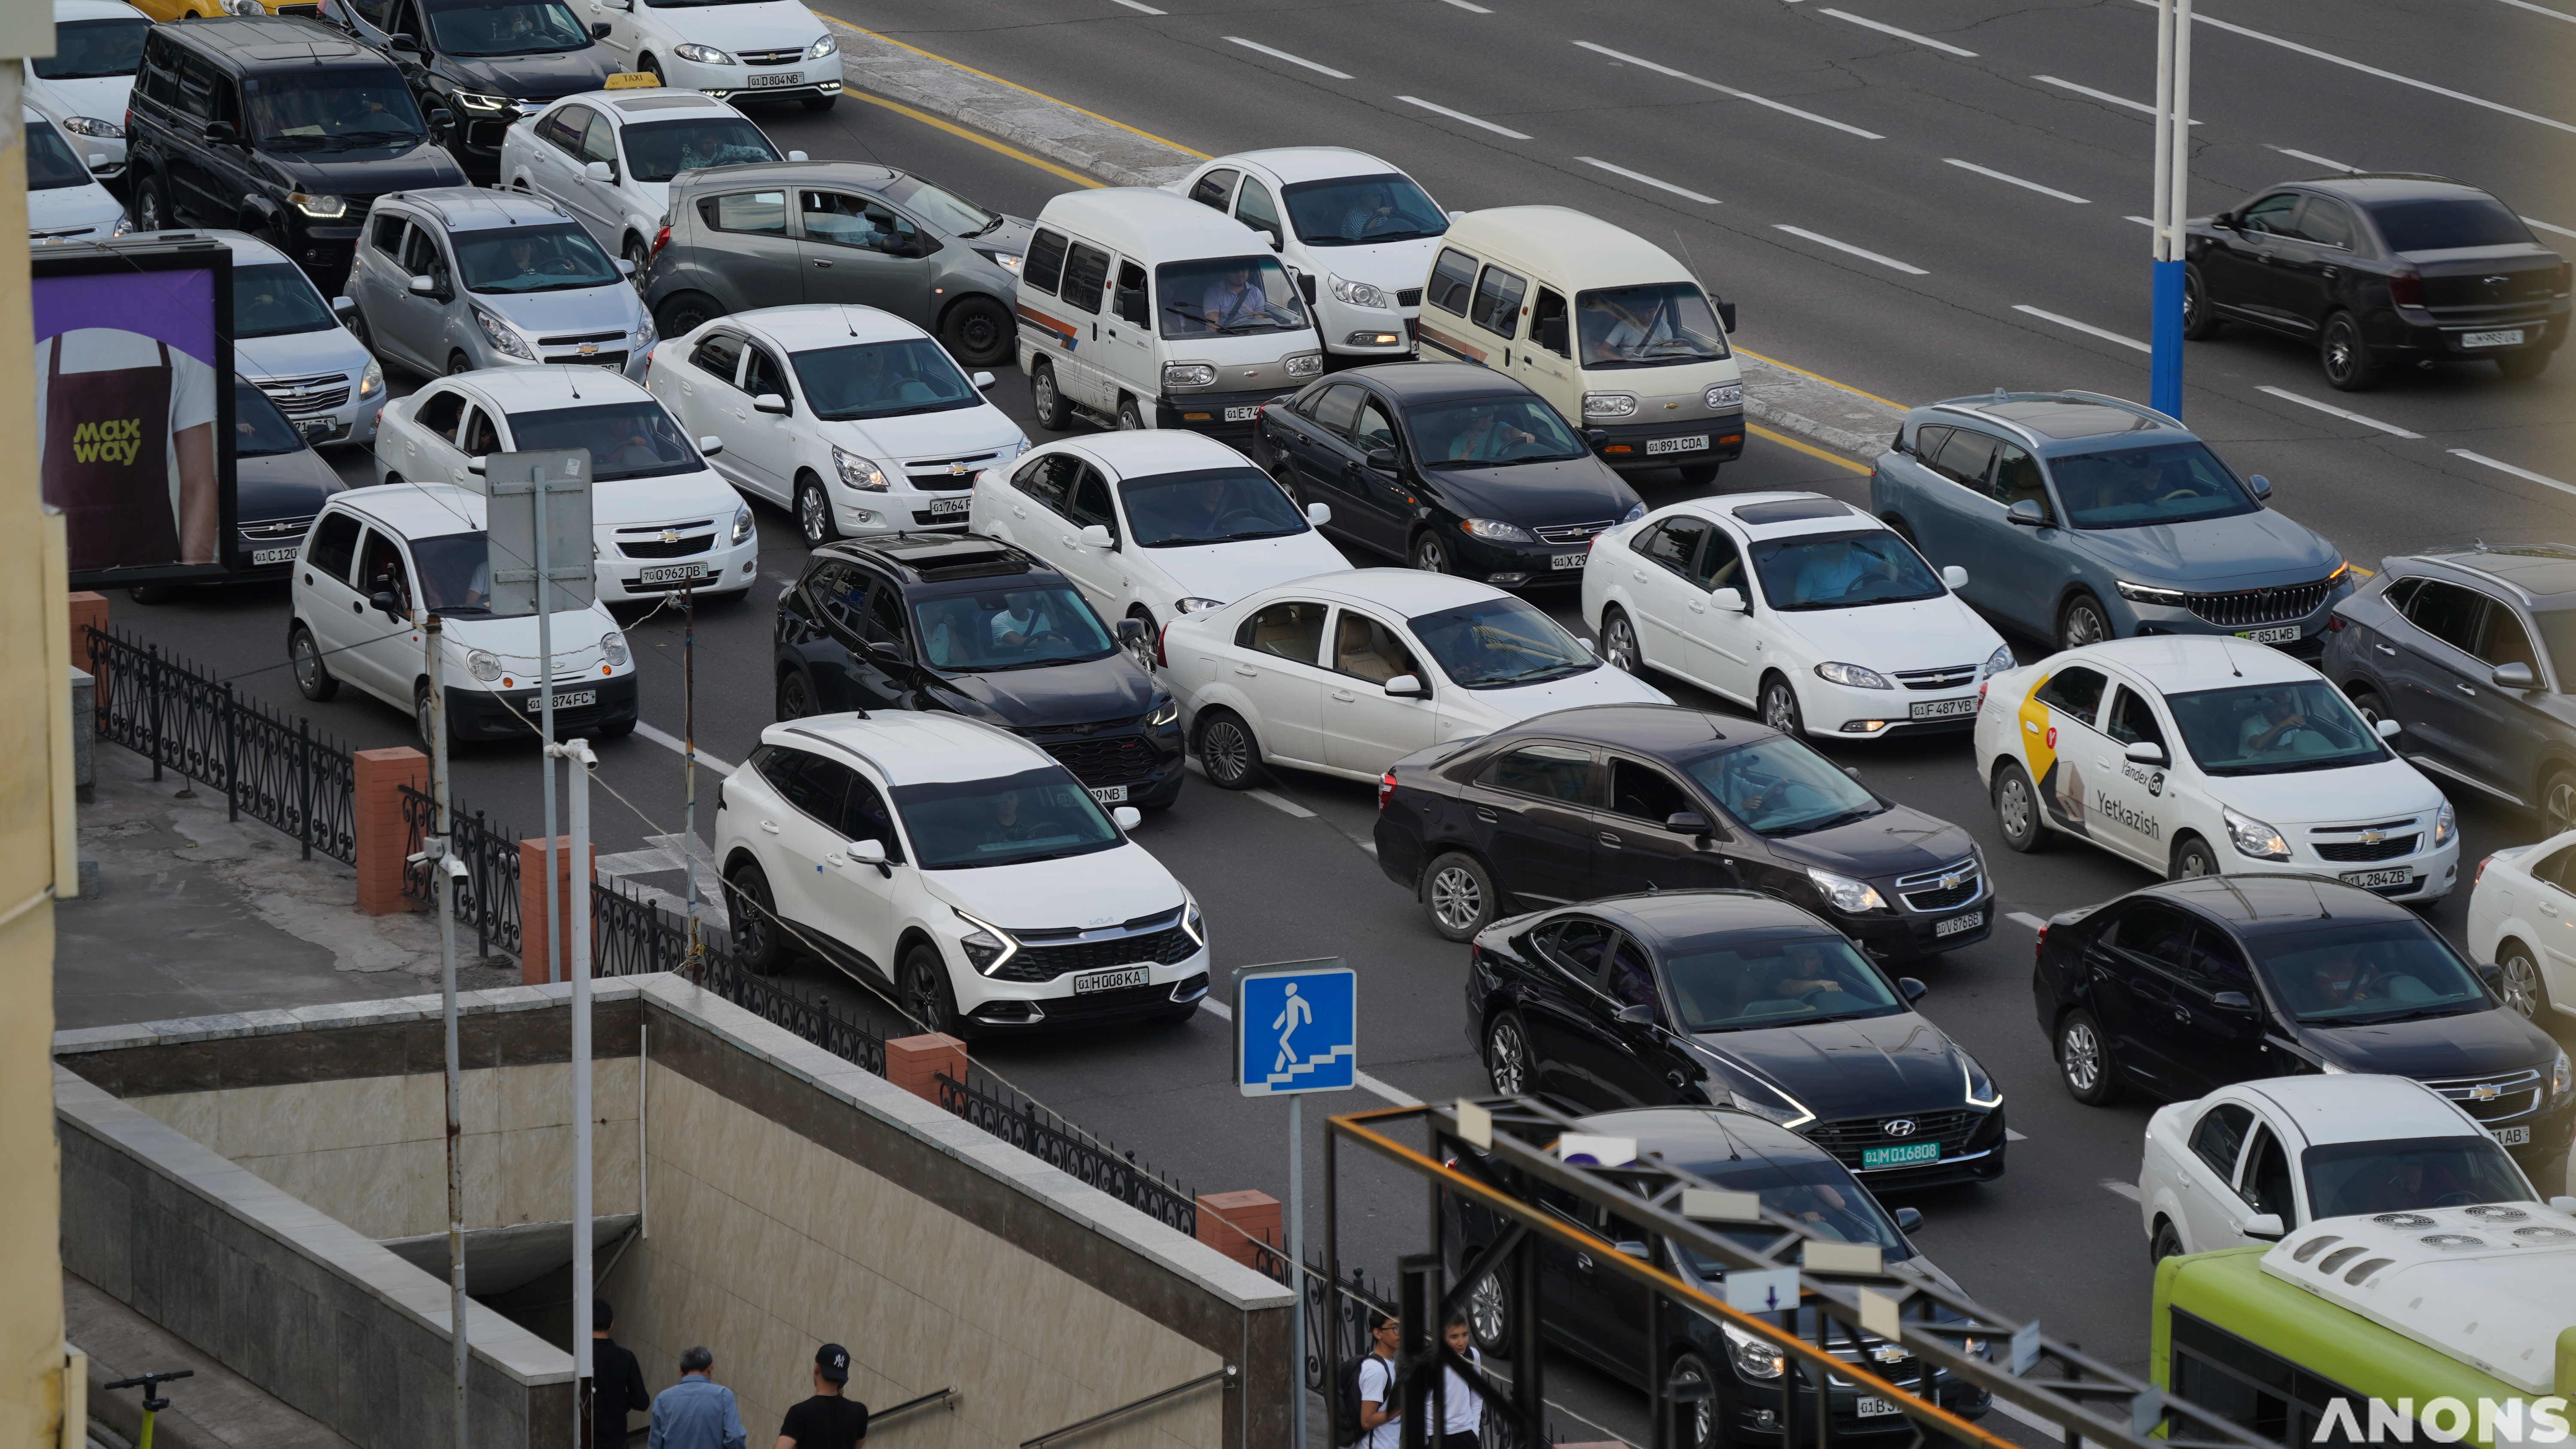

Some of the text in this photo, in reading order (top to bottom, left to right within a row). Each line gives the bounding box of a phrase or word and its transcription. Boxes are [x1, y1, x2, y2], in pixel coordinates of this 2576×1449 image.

[73, 418, 140, 443] max
[73, 439, 141, 466] way
[1649, 443, 1659, 451] 01
[934, 503, 943, 512] 01
[530, 700, 541, 709] 01
[2122, 759, 2161, 793] Yandex Go
[2098, 789, 2160, 839] Yetkazish
